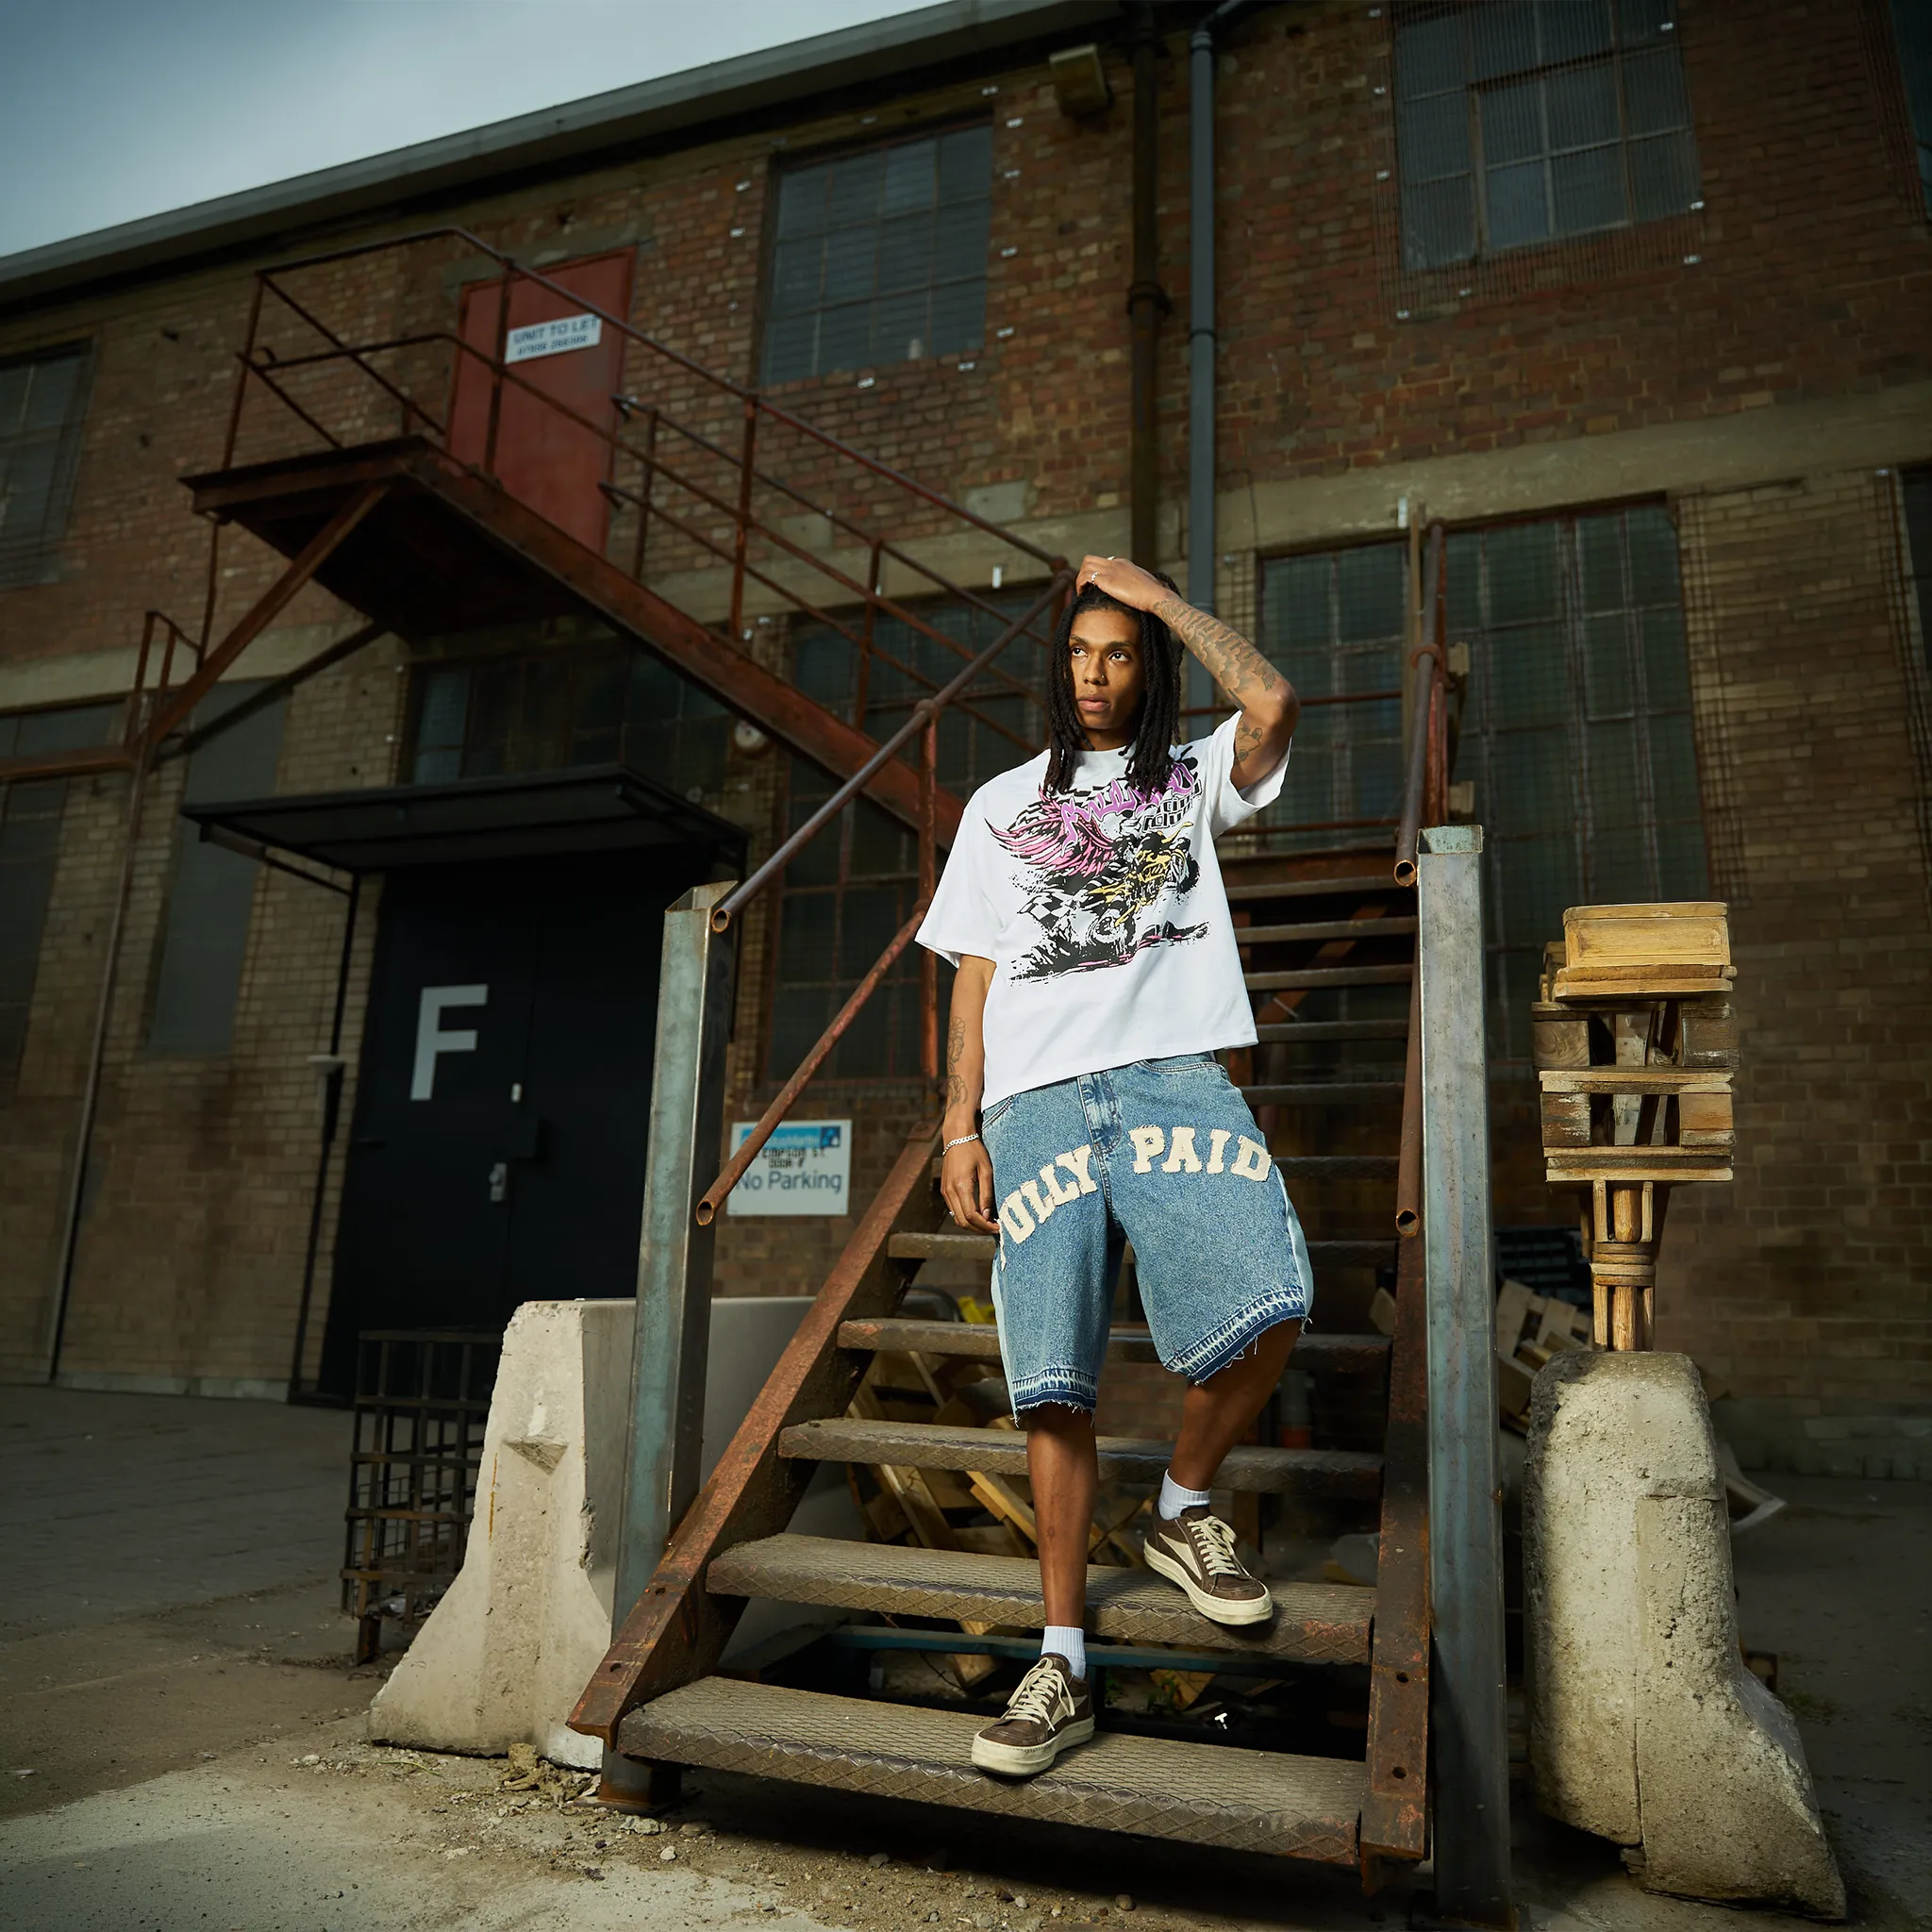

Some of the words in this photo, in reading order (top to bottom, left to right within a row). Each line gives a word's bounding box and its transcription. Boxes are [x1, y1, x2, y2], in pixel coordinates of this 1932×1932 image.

[513, 326, 545, 345] UNIT
[550, 322, 569, 338] TO
[572, 315, 599, 333] LET
[409, 983, 489, 1101] F
[736, 1171, 763, 1191] No
[768, 1170, 842, 1195] Parking
[996, 1144, 1097, 1271] ULLY
[1128, 1124, 1272, 1182] PAID
